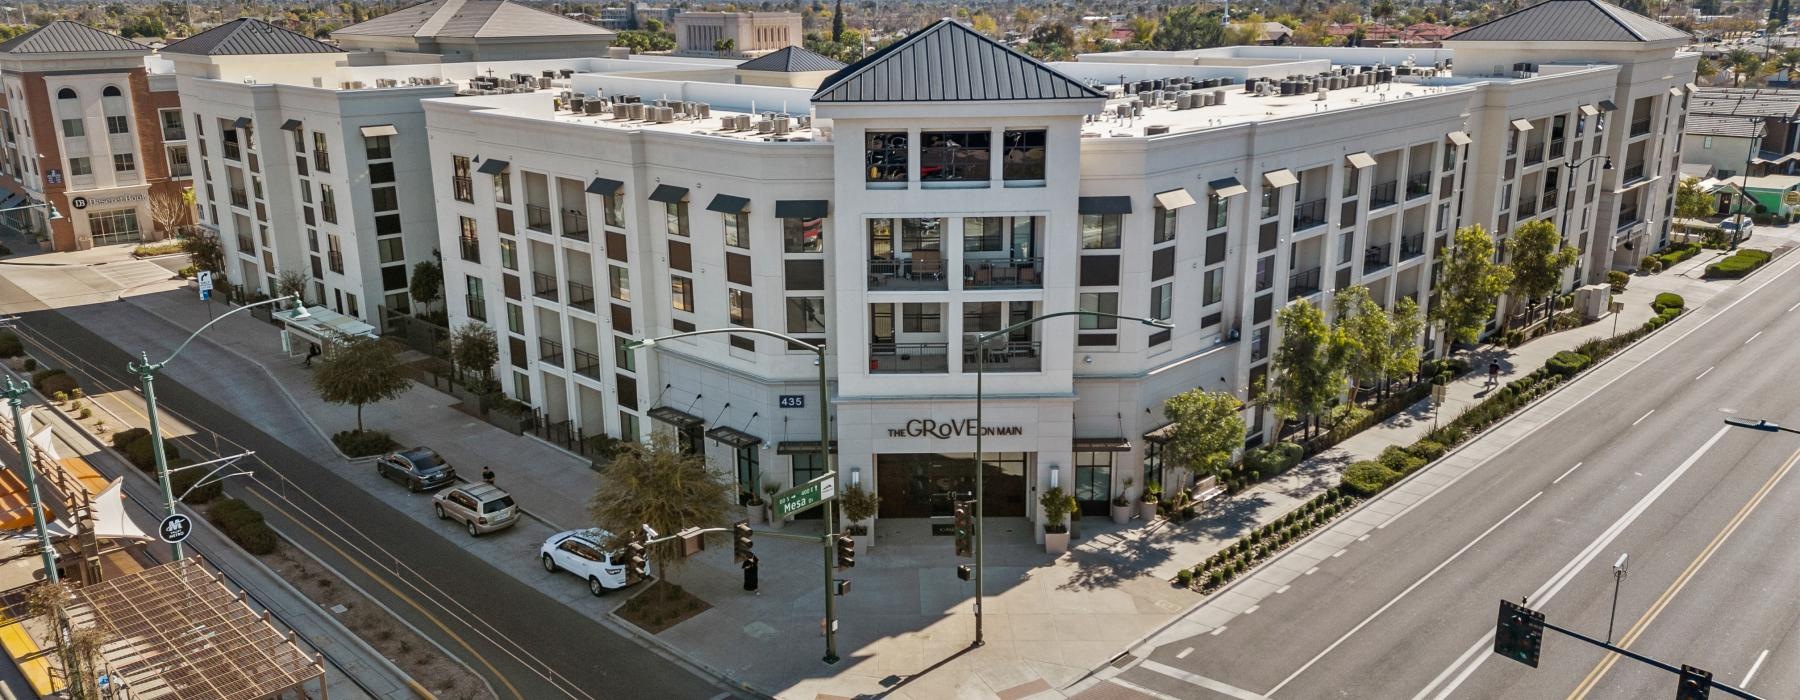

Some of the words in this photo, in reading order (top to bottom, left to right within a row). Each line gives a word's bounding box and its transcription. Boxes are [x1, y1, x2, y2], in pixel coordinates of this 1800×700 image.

[781, 397, 802, 406] 435
[888, 428, 906, 437] THE
[996, 426, 1023, 436] MAIN
[784, 498, 806, 514] Mesa
